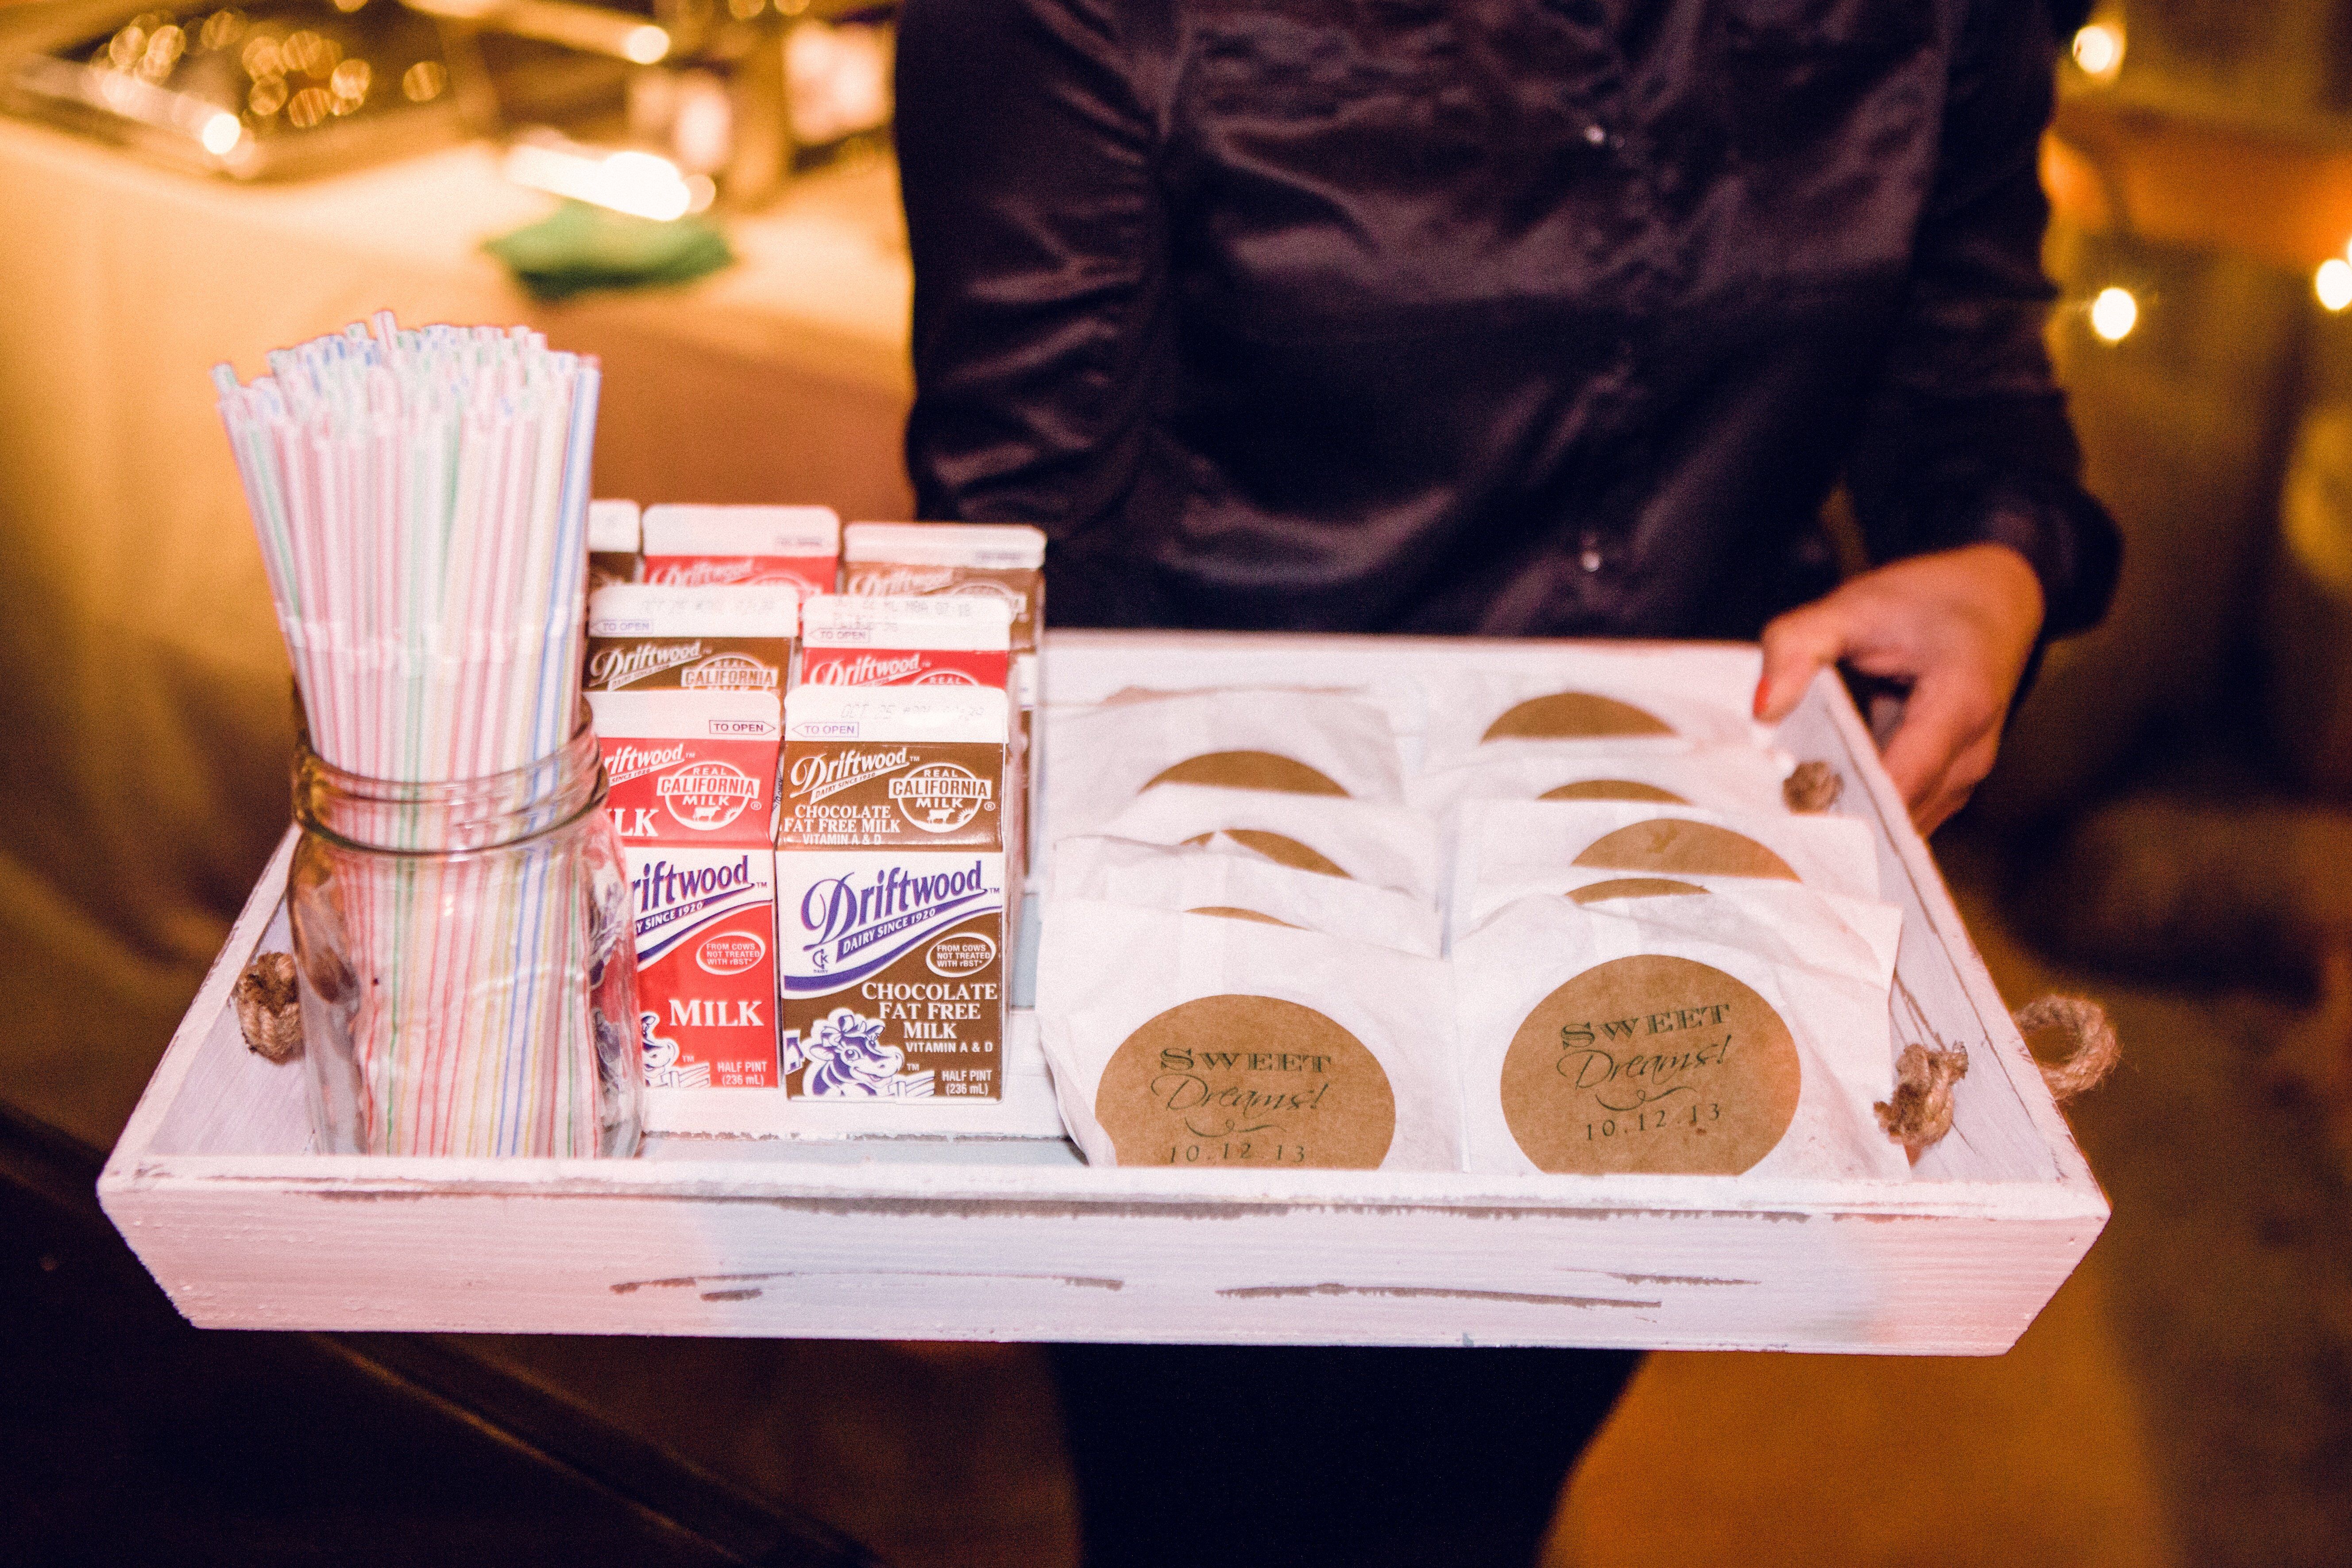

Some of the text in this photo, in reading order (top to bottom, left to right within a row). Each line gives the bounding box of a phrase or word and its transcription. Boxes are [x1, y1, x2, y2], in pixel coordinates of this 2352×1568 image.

[822, 631, 833, 639] TO
[589, 640, 701, 687] Driftwood
[809, 653, 920, 686] Driftwood
[686, 671, 773, 685] CALIFORNIA
[713, 723, 764, 732] TO OPEN
[805, 725, 854, 734] TO OPEN
[604, 743, 684, 775] riftwood
[693, 767, 727, 776] REAL
[790, 748, 906, 798] Driftwood
[924, 769, 958, 777] REAL
[661, 778, 754, 796] CALIFORNIA
[815, 785, 836, 799] DAIRY
[838, 777, 858, 788] SINCE
[892, 780, 987, 796] CALIFORNIA
[682, 796, 730, 806] MILK
[915, 797, 963, 808] MILK
[795, 805, 891, 819] CHOCOLATE
[784, 818, 900, 833] FAT FREE MILK
[803, 834, 882, 845] VITAMIN A & D
[632, 855, 748, 913] riftwood
[801, 860, 981, 951] Driftwood
[645, 911, 676, 930] SINCE
[678, 901, 703, 917] 1920
[842, 909, 935, 955] DAIRY SINCE 1920
[862, 982, 997, 1000] CHOCOLATE
[668, 999, 764, 1026] MILK
[879, 1002, 981, 1020] FAT FREE
[903, 1021, 957, 1039] MILK
[1560, 1004, 1730, 1050] SWEET
[906, 1042, 993, 1052] VITAMIN A & D
[717, 1062, 767, 1073] HALF PINT
[1160, 1047, 1332, 1073] SWEET
[1557, 1034, 1732, 1090] Dreams!
[722, 1075, 765, 1086] (236 mL)
[942, 1070, 992, 1081] HALF PINT
[946, 1083, 988, 1096] (236 mL)
[1151, 1073, 1329, 1120] Dreams!
